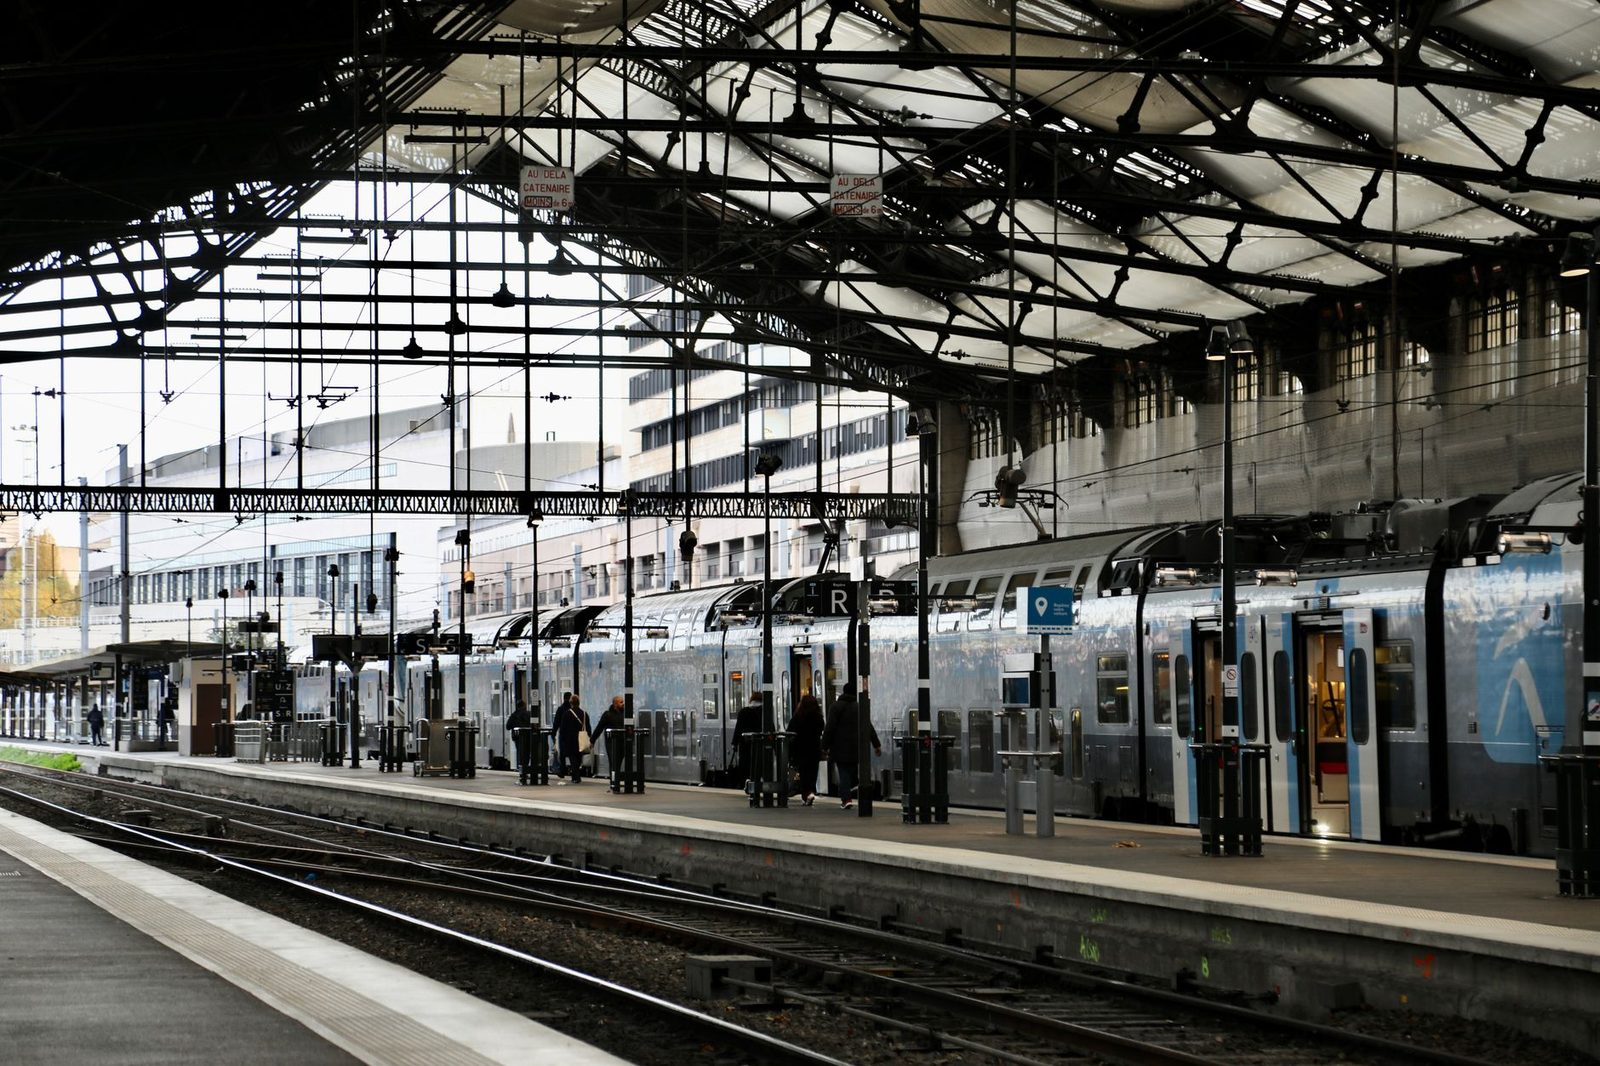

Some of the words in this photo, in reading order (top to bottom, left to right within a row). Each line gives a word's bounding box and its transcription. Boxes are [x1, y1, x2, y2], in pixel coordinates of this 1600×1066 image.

[528, 169, 539, 178] AU
[544, 169, 567, 179] DELA
[838, 177, 849, 186] AU
[853, 177, 875, 187] DELA
[523, 183, 571, 194] CATENAIRE
[834, 191, 880, 200] CATENAIRE
[526, 196, 552, 207] MOINS
[561, 198, 568, 207] 6
[836, 204, 862, 214] MOINS
[870, 205, 877, 214] 6
[831, 590, 848, 613] R
[416, 638, 426, 654] S
[274, 683, 282, 691] U
[285, 683, 292, 691] Z
[274, 710, 282, 718] S
[285, 709, 292, 718] R
